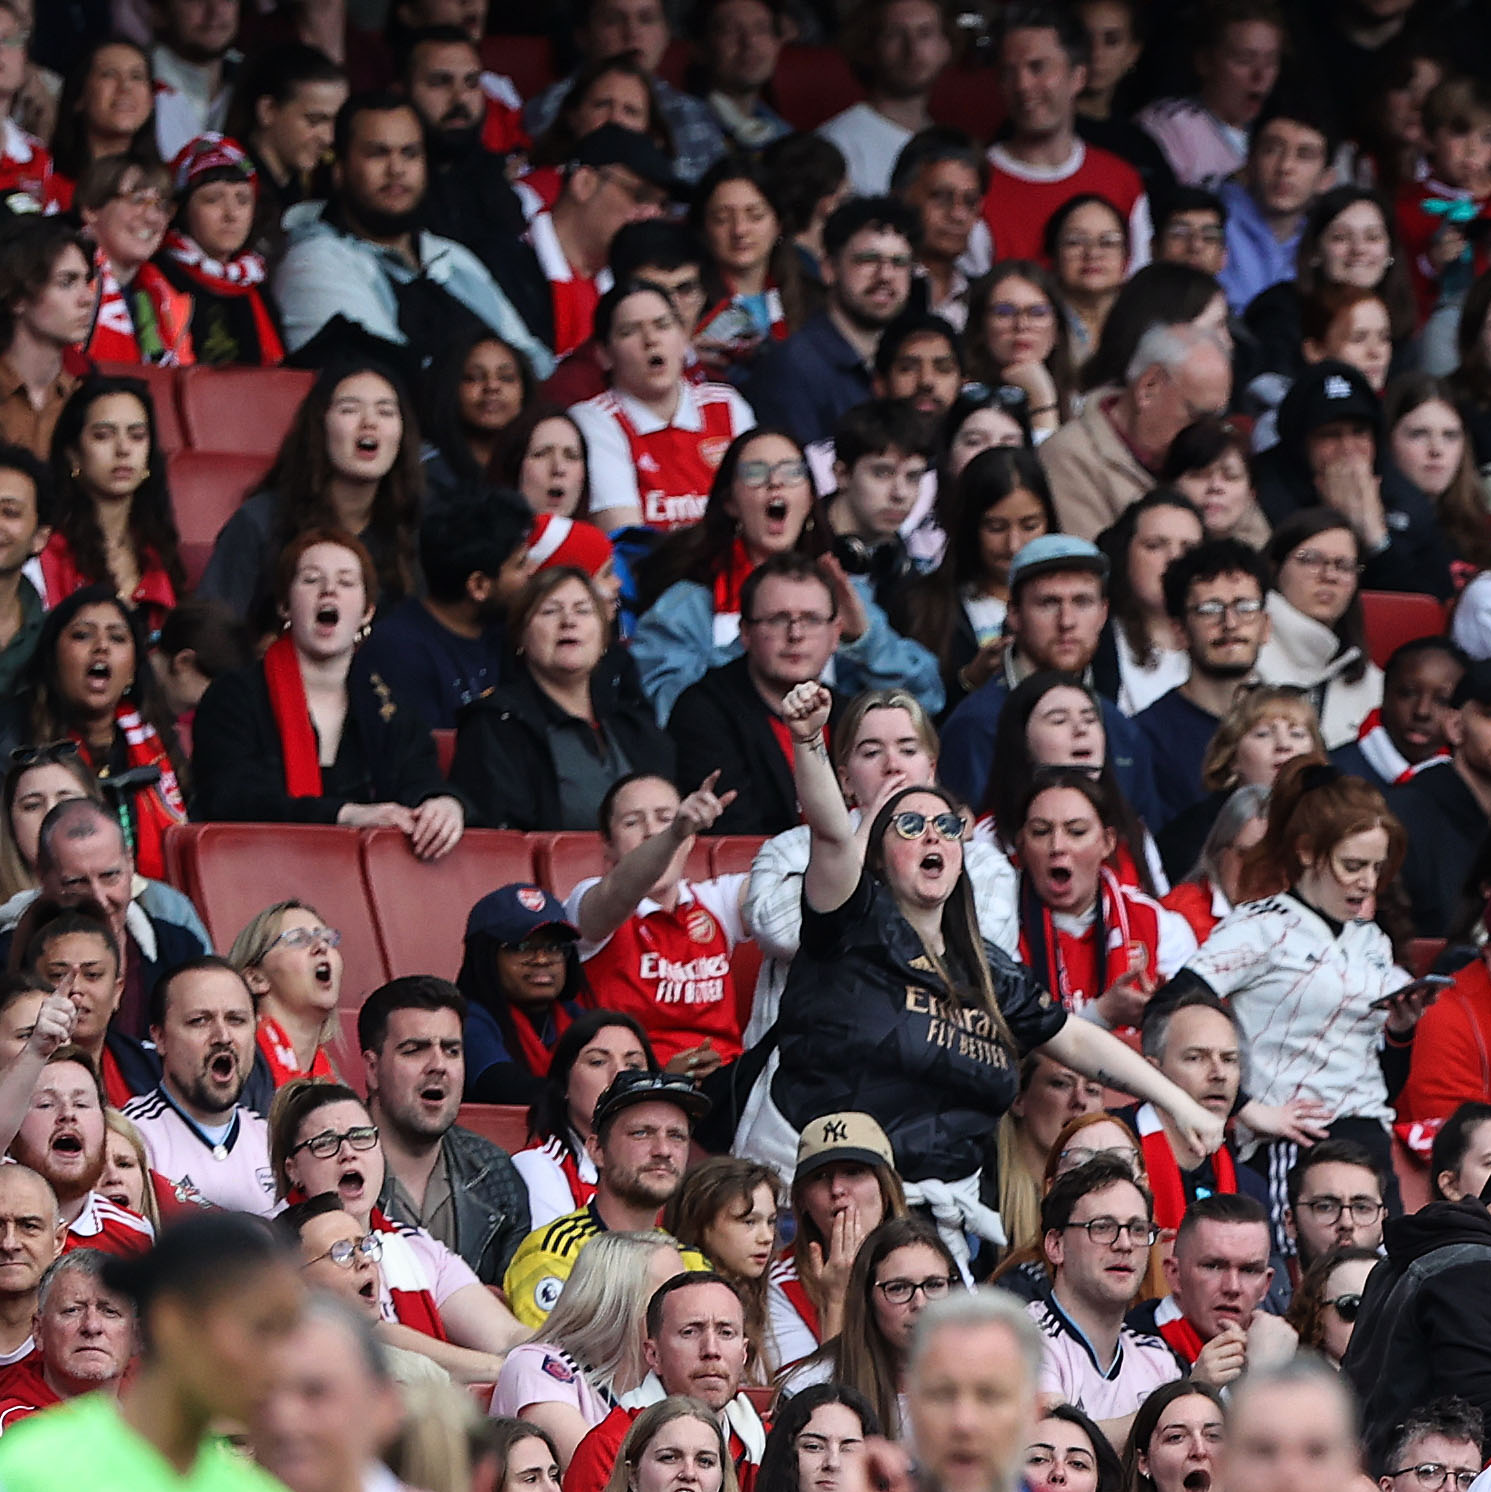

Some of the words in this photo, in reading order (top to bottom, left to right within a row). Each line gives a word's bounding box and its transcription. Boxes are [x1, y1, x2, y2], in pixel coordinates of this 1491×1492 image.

[927, 1019, 956, 1049] FLY
[958, 1033, 1009, 1071] BETTER
[823, 1119, 848, 1143] NY
